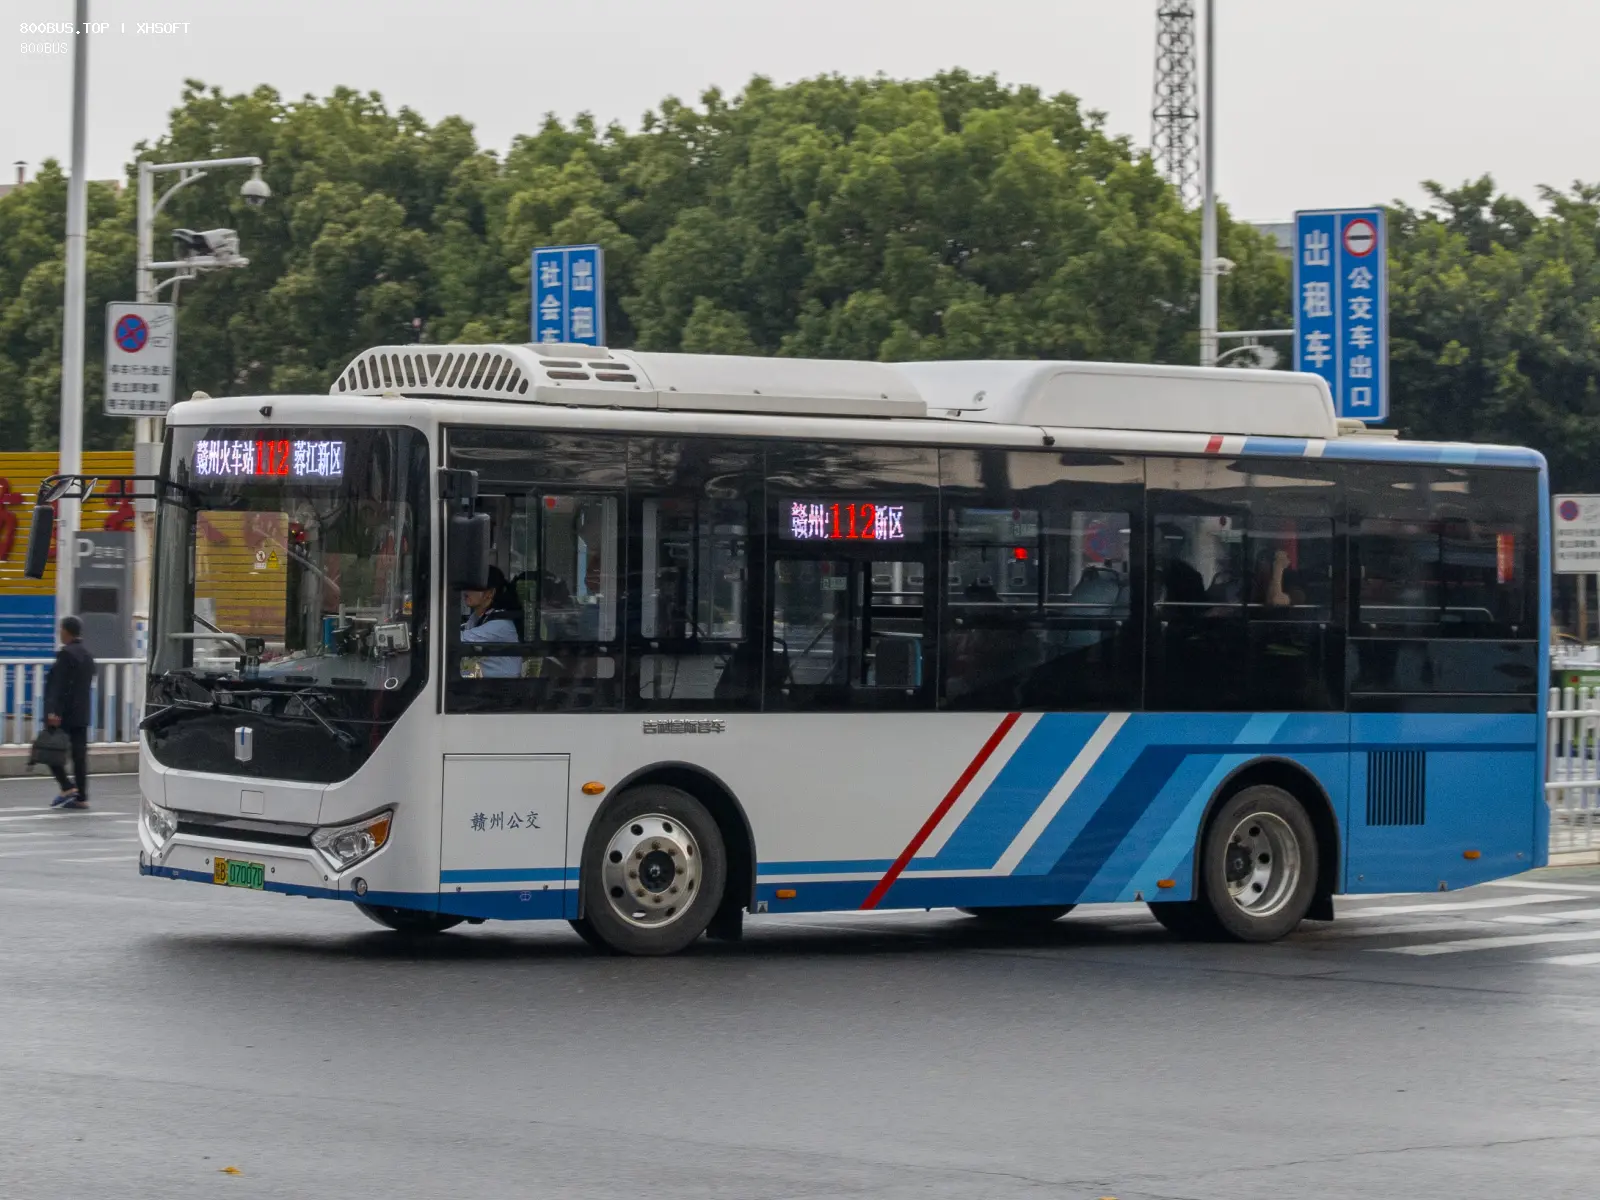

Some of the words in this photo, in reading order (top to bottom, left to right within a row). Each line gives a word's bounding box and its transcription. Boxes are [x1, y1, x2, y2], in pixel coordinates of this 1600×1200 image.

[1347, 266, 1375, 407] 公交车出口
[196, 439, 255, 476] 赣州火车站
[255, 439, 290, 476] 112
[293, 440, 343, 476] 蓉江新区
[829, 503, 876, 540] 112
[470, 810, 541, 832] 赣州公交
